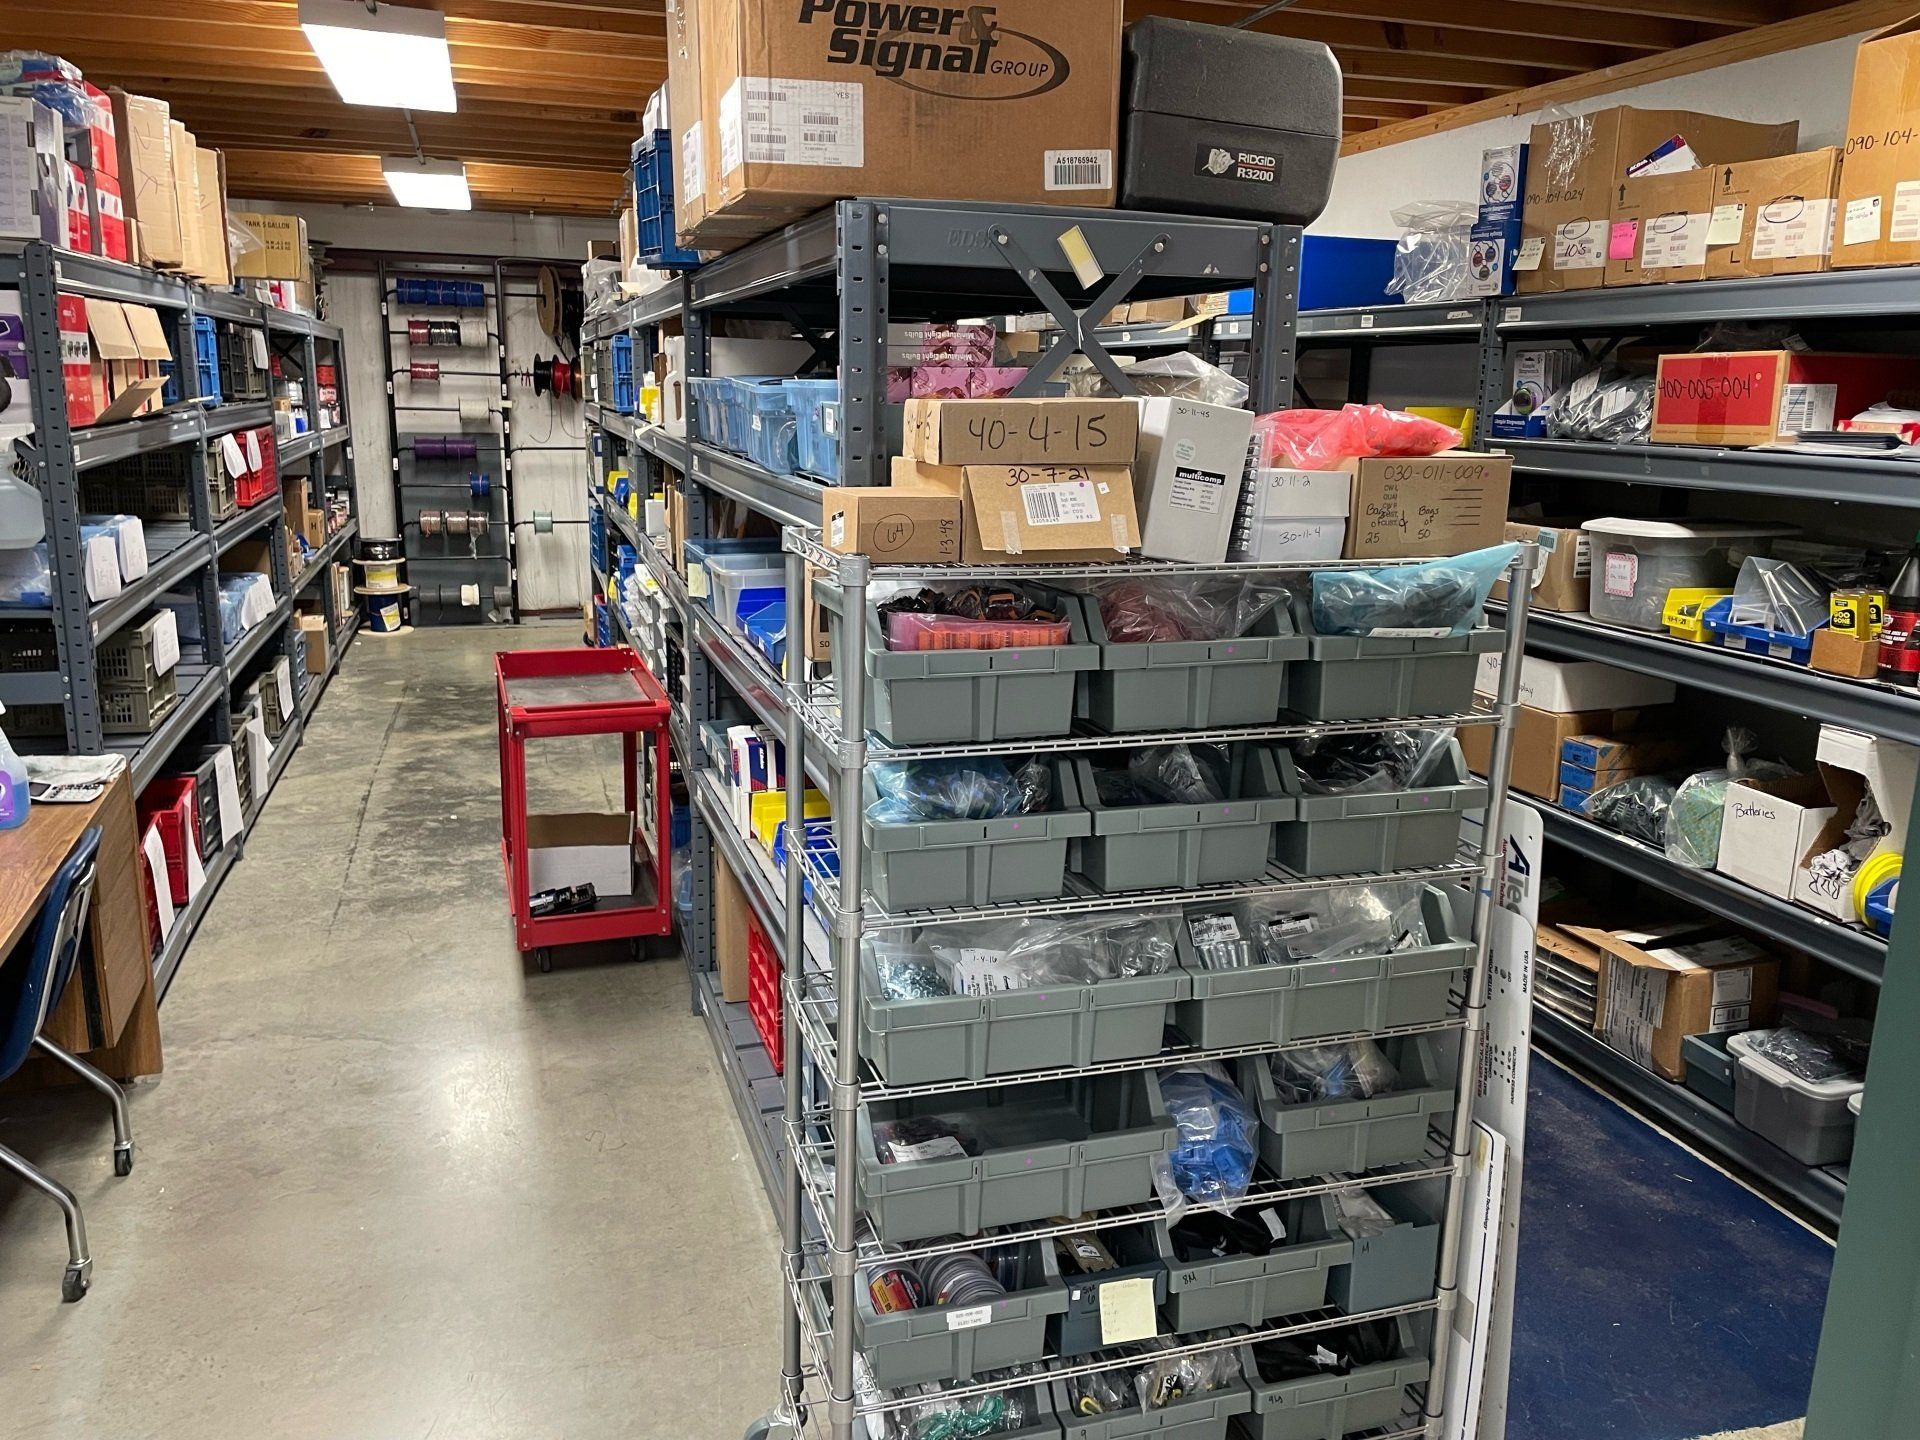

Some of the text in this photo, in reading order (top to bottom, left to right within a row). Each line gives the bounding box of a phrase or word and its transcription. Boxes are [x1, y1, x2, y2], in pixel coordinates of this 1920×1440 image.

[798, 0, 963, 35] Power
[827, 27, 990, 77] Signal
[990, 60, 1049, 77] GROUP
[836, 92, 850, 100] YES
[1056, 156, 1098, 165] A518765942
[1238, 152, 1276, 167] RIDGID
[1236, 167, 1274, 182] R3200
[904, 331, 923, 340] Bulbs
[902, 352, 921, 361] Bulbs
[1658, 374, 1750, 400] 400-005-004
[968, 414, 1107, 451] 40-4-15
[1006, 467, 1089, 487] 30-7-21
[1179, 471, 1221, 484] multicomp
[1384, 464, 1485, 481] 030-011-009
[1418, 505, 1440, 516] Bags
[1365, 532, 1380, 544] 25
[1418, 529, 1431, 540] 50
[1731, 801, 1776, 820] Batteries
